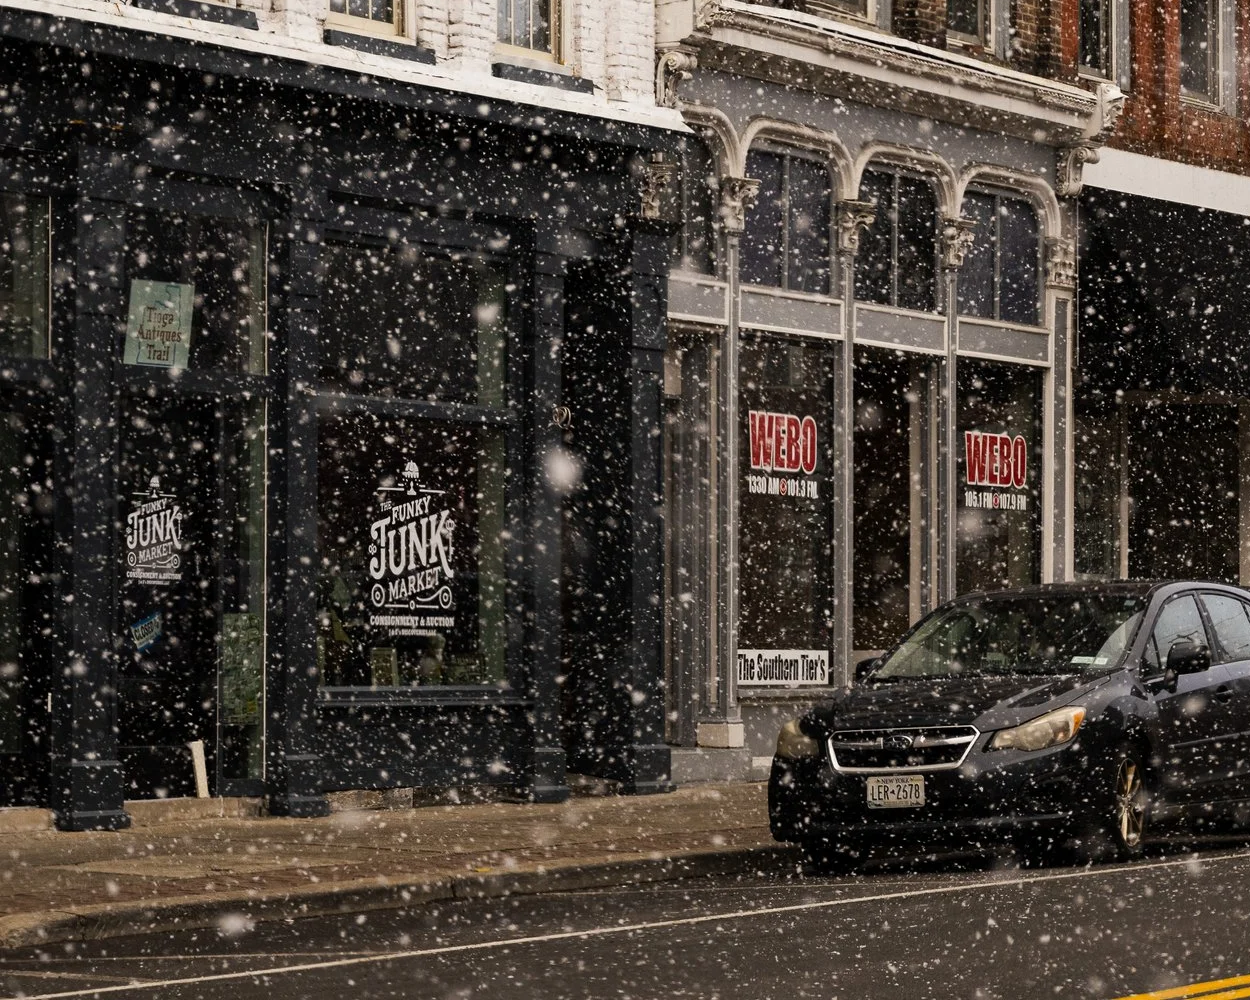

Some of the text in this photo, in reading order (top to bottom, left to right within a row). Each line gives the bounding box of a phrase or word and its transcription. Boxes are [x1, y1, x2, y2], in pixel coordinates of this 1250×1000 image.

[145, 306, 174, 327] Tioga
[137, 324, 182, 345] Antiques
[146, 343, 170, 361] Trail
[748, 410, 817, 475] WEBO
[965, 431, 1026, 489] WEBO
[749, 475, 767, 494] 1330
[768, 476, 780, 495] AM
[787, 479, 806, 498] 101.3
[141, 498, 168, 516] FUNKY
[380, 495, 432, 525] THE FUNKY
[965, 491, 1027, 511] 105.1 FM 107.9 FM
[127, 505, 182, 550] JUNK
[138, 541, 173, 564] MARKET
[369, 509, 455, 581] JUNK
[388, 566, 442, 603] MARKET
[134, 620, 154, 641] CLOSED
[370, 615, 455, 628] CONSIGNMENT & AUCTION
[738, 653, 826, 681] The Southern Tier's
[872, 783, 920, 801] LER 2678
